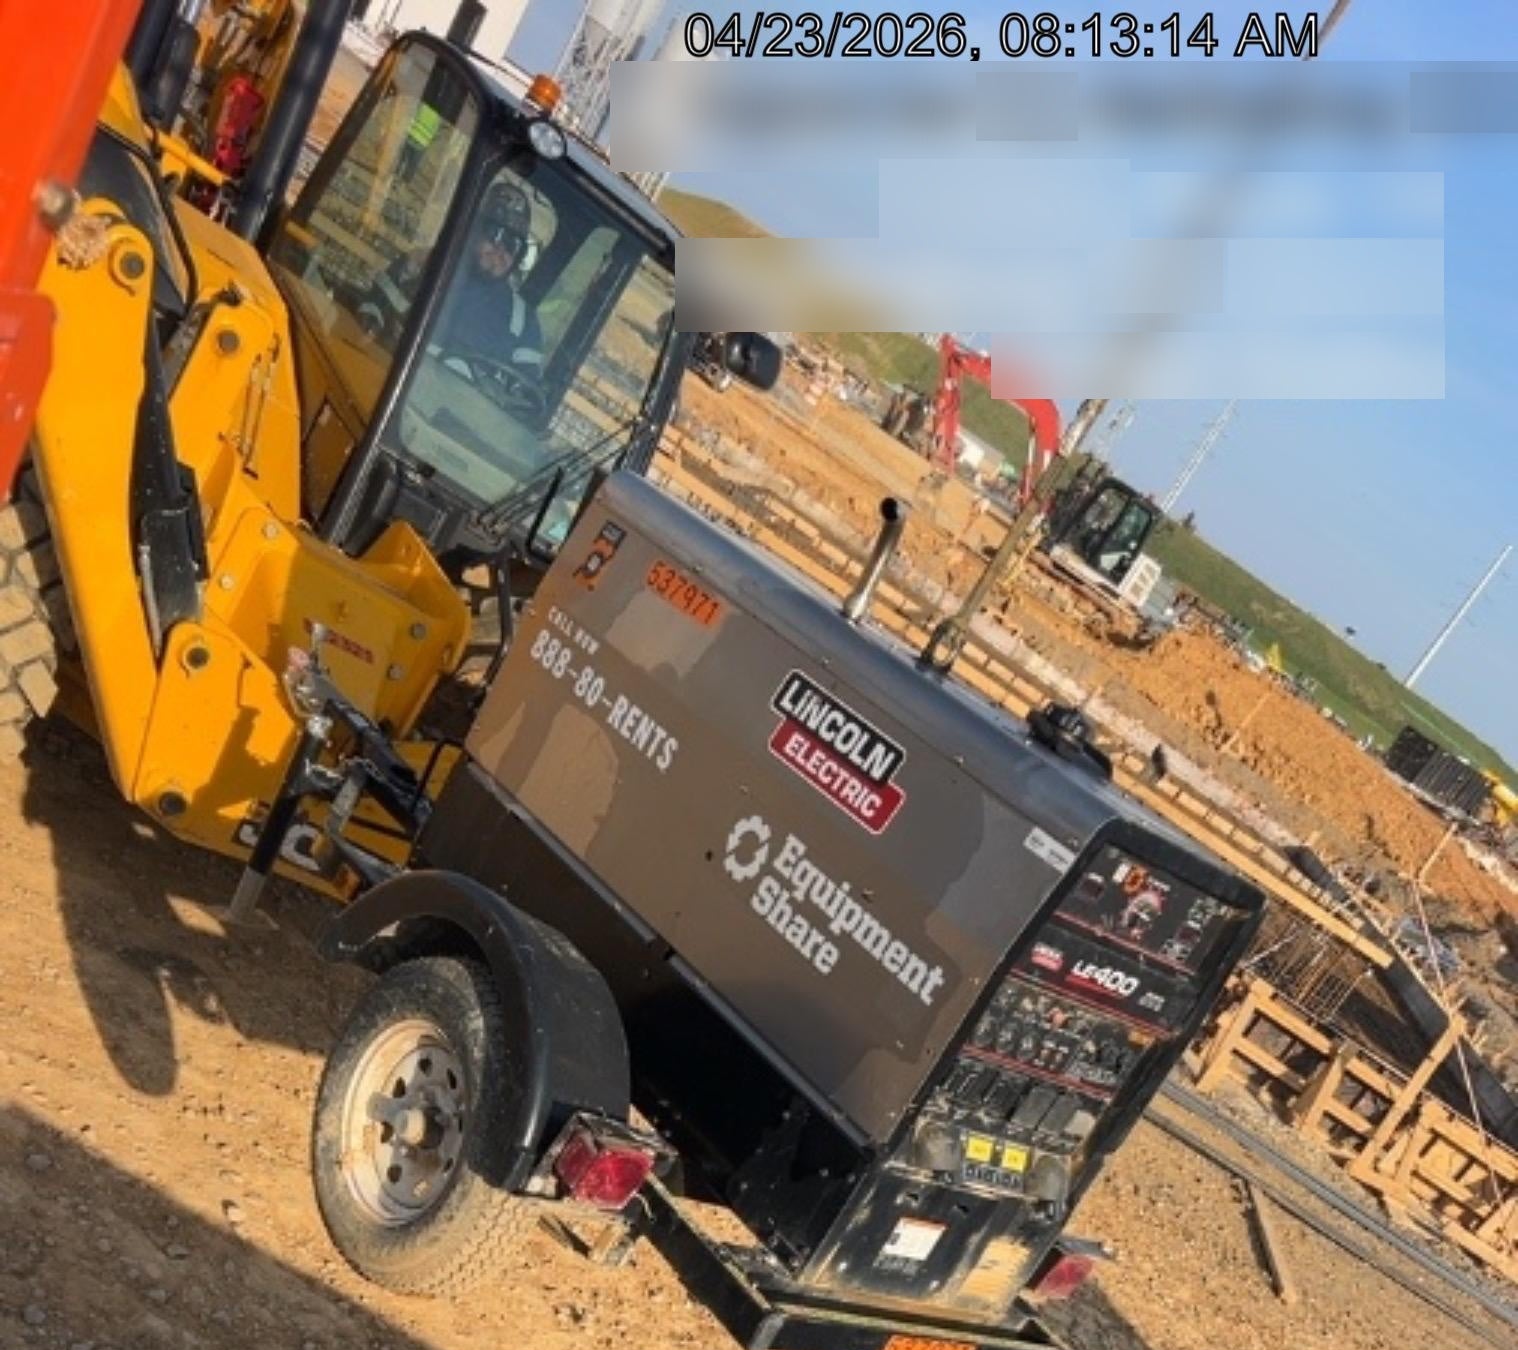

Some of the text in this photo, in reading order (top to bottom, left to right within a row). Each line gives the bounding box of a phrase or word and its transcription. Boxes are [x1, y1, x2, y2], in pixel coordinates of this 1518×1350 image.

[647, 560, 721, 625] 537971
[530, 629, 679, 773] 888-80-RENTS
[779, 679, 896, 781] LINCOLN
[783, 731, 883, 818] ELECTRIC
[752, 875, 840, 975] Share
[773, 833, 945, 1006] Equipment
